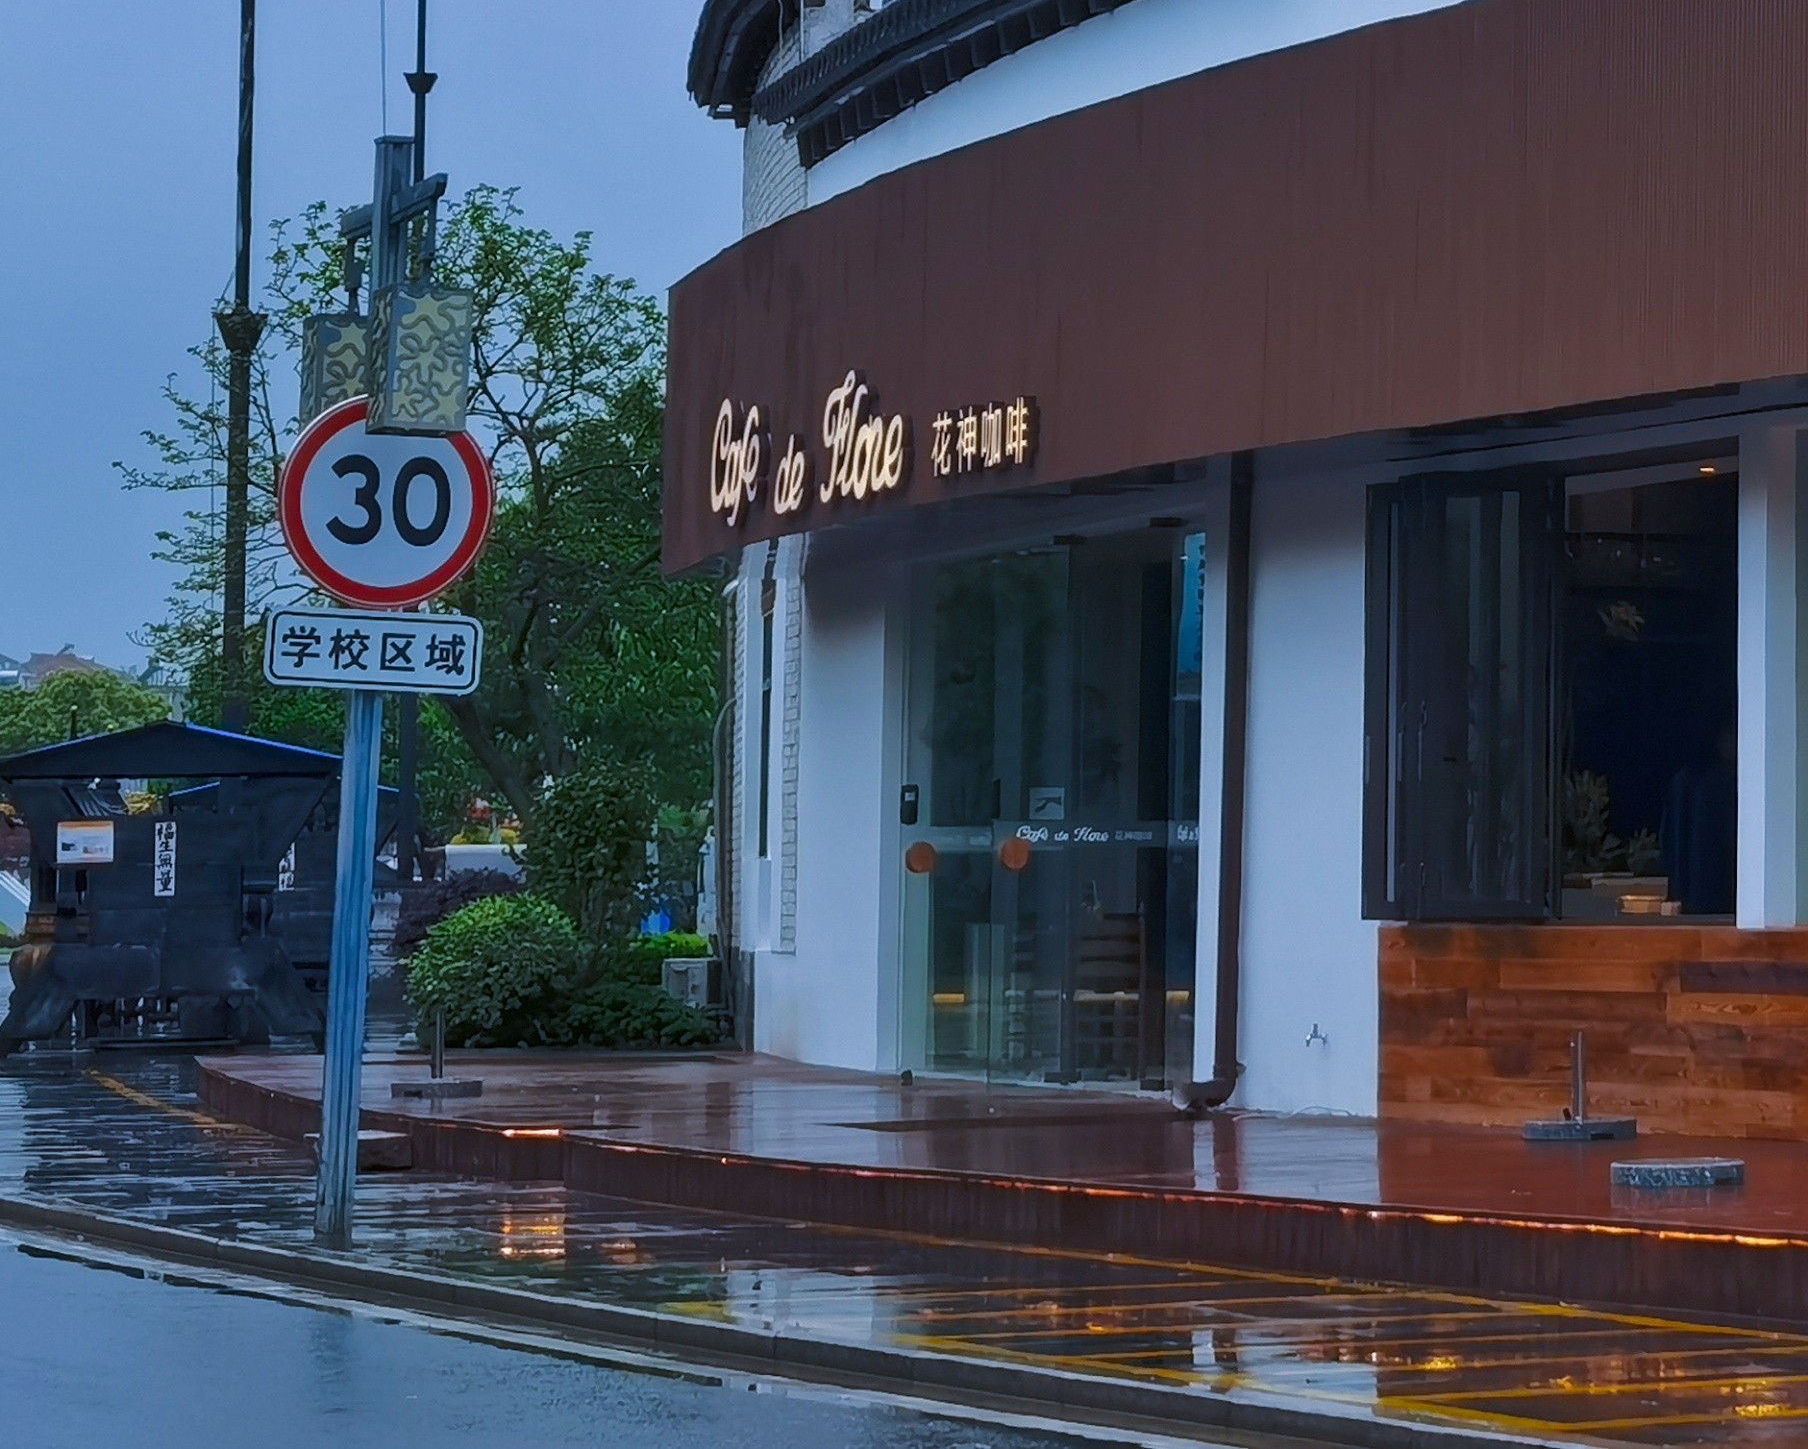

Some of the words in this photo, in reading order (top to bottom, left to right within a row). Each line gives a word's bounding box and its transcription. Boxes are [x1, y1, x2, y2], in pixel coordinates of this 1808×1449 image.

[774, 433, 806, 515] de
[820, 369, 904, 504] Flore
[931, 396, 1029, 477] 花神咖啡
[325, 453, 452, 547] 30
[280, 625, 467, 676] 学校区域
